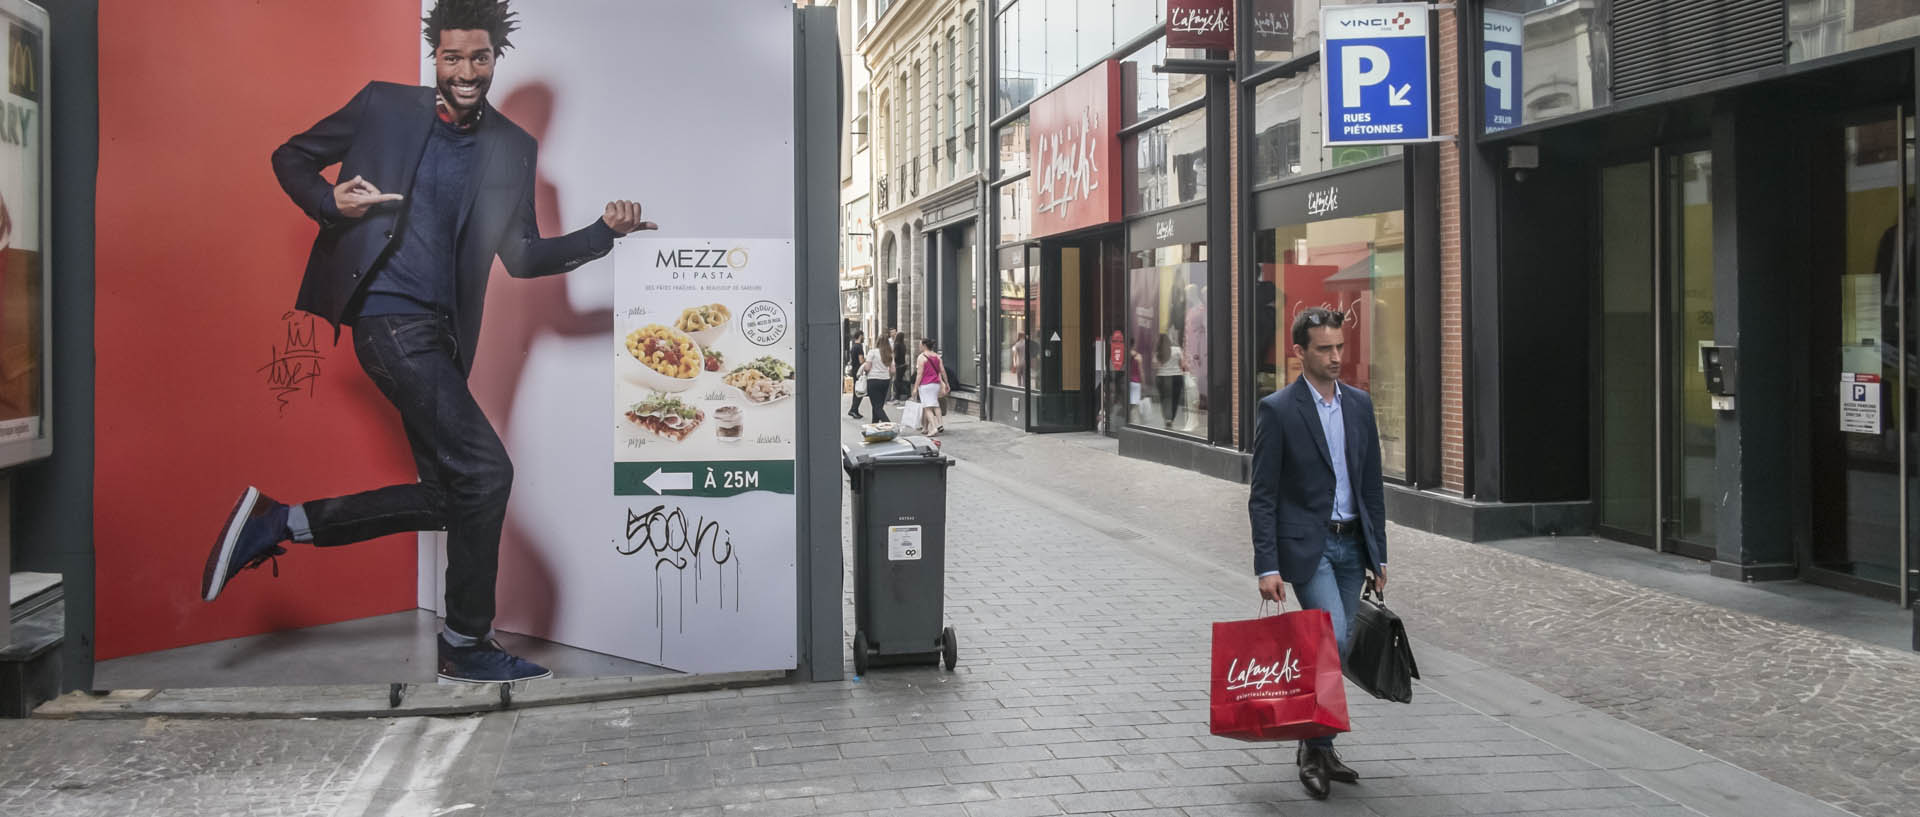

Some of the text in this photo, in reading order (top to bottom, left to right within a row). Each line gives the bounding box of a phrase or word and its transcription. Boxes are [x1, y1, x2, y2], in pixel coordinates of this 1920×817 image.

[1172, 7, 1230, 35] Lafayette
[1340, 18, 1387, 27] VINCI
[1341, 45, 1390, 108] P
[1343, 113, 1371, 123] RUES
[1344, 123, 1404, 135] PIÉTONNES
[656, 248, 748, 269] MEZZO
[672, 272, 733, 280] DI PASTA
[704, 466, 759, 488] À 25M
[1226, 647, 1302, 690] Lafayette
